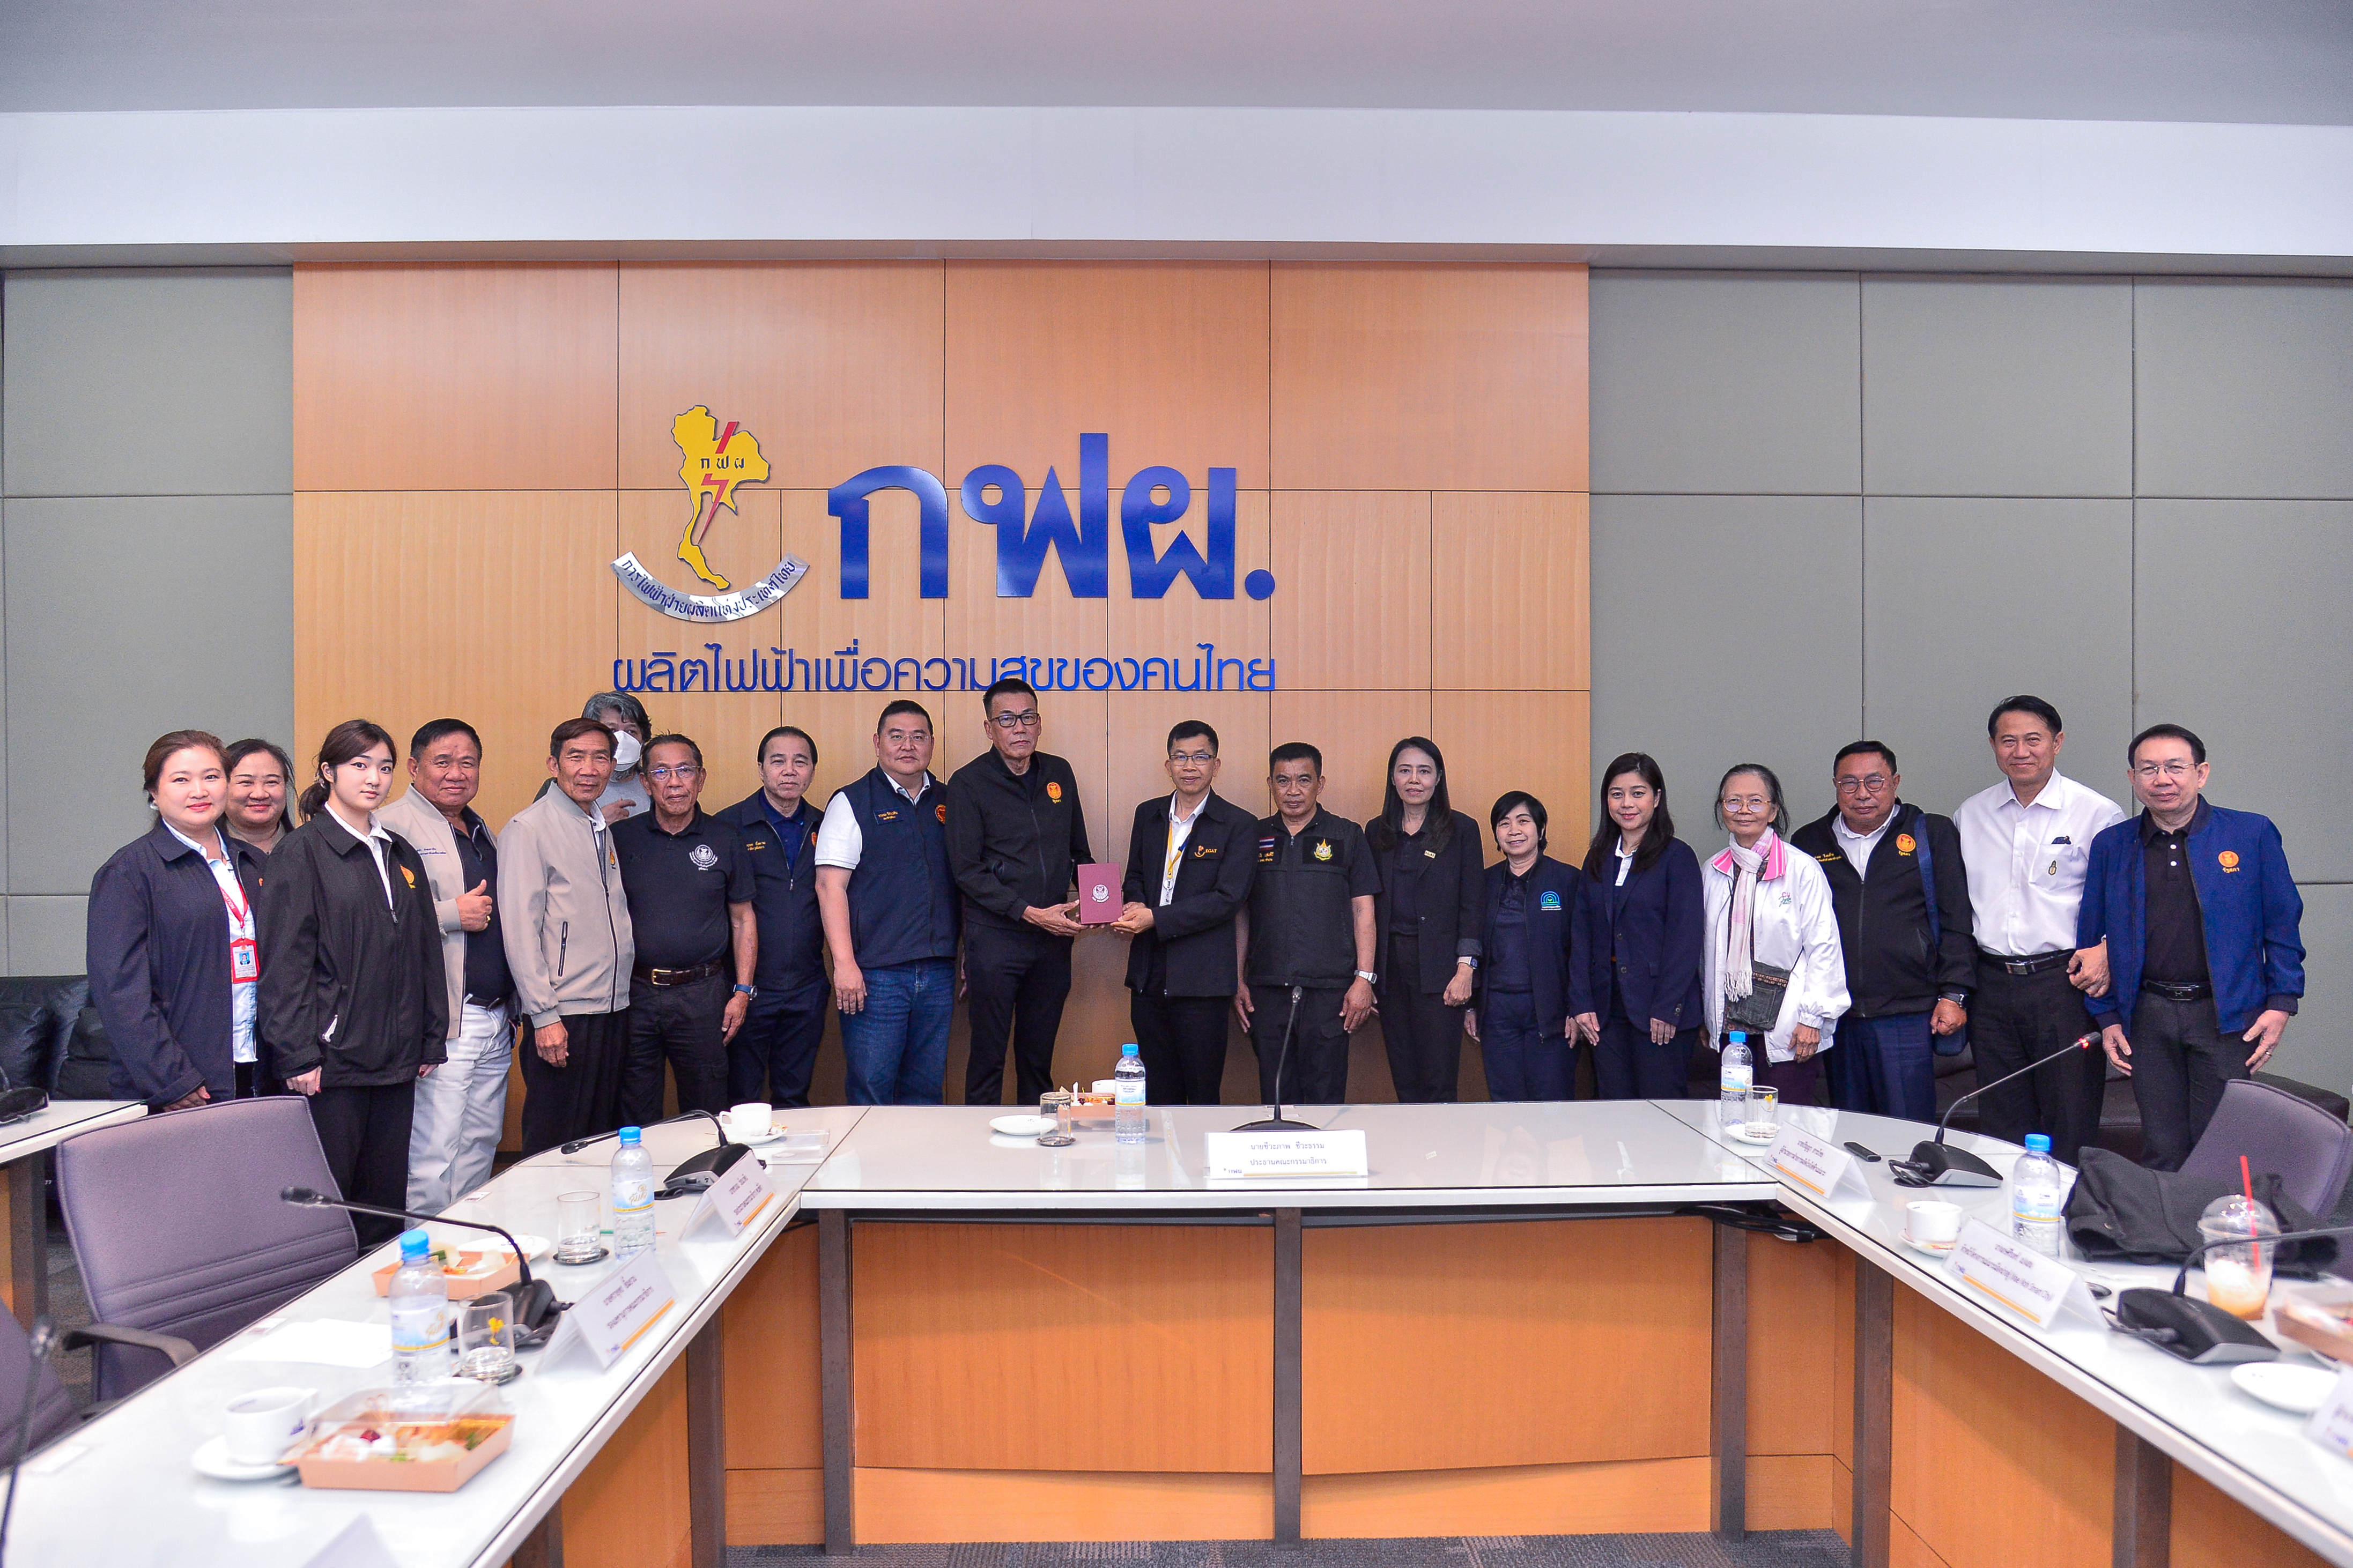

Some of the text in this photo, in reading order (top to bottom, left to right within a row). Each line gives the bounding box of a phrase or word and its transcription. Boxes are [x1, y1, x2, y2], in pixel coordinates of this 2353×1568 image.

[827, 433, 1275, 600] กฟผ.
[622, 560, 796, 617] การไฟฟ้าฝ่ายผลิตแห่งประเทศไทย
[613, 638, 1275, 691] ผลิตไฟฟ้าเพื่อความสขของคนไทย
[1250, 1157, 1327, 1165] ประธานคณะกรรมาธิการ
[1251, 1141, 1325, 1150] นายชีวะภาพ ชีวะธรรม
